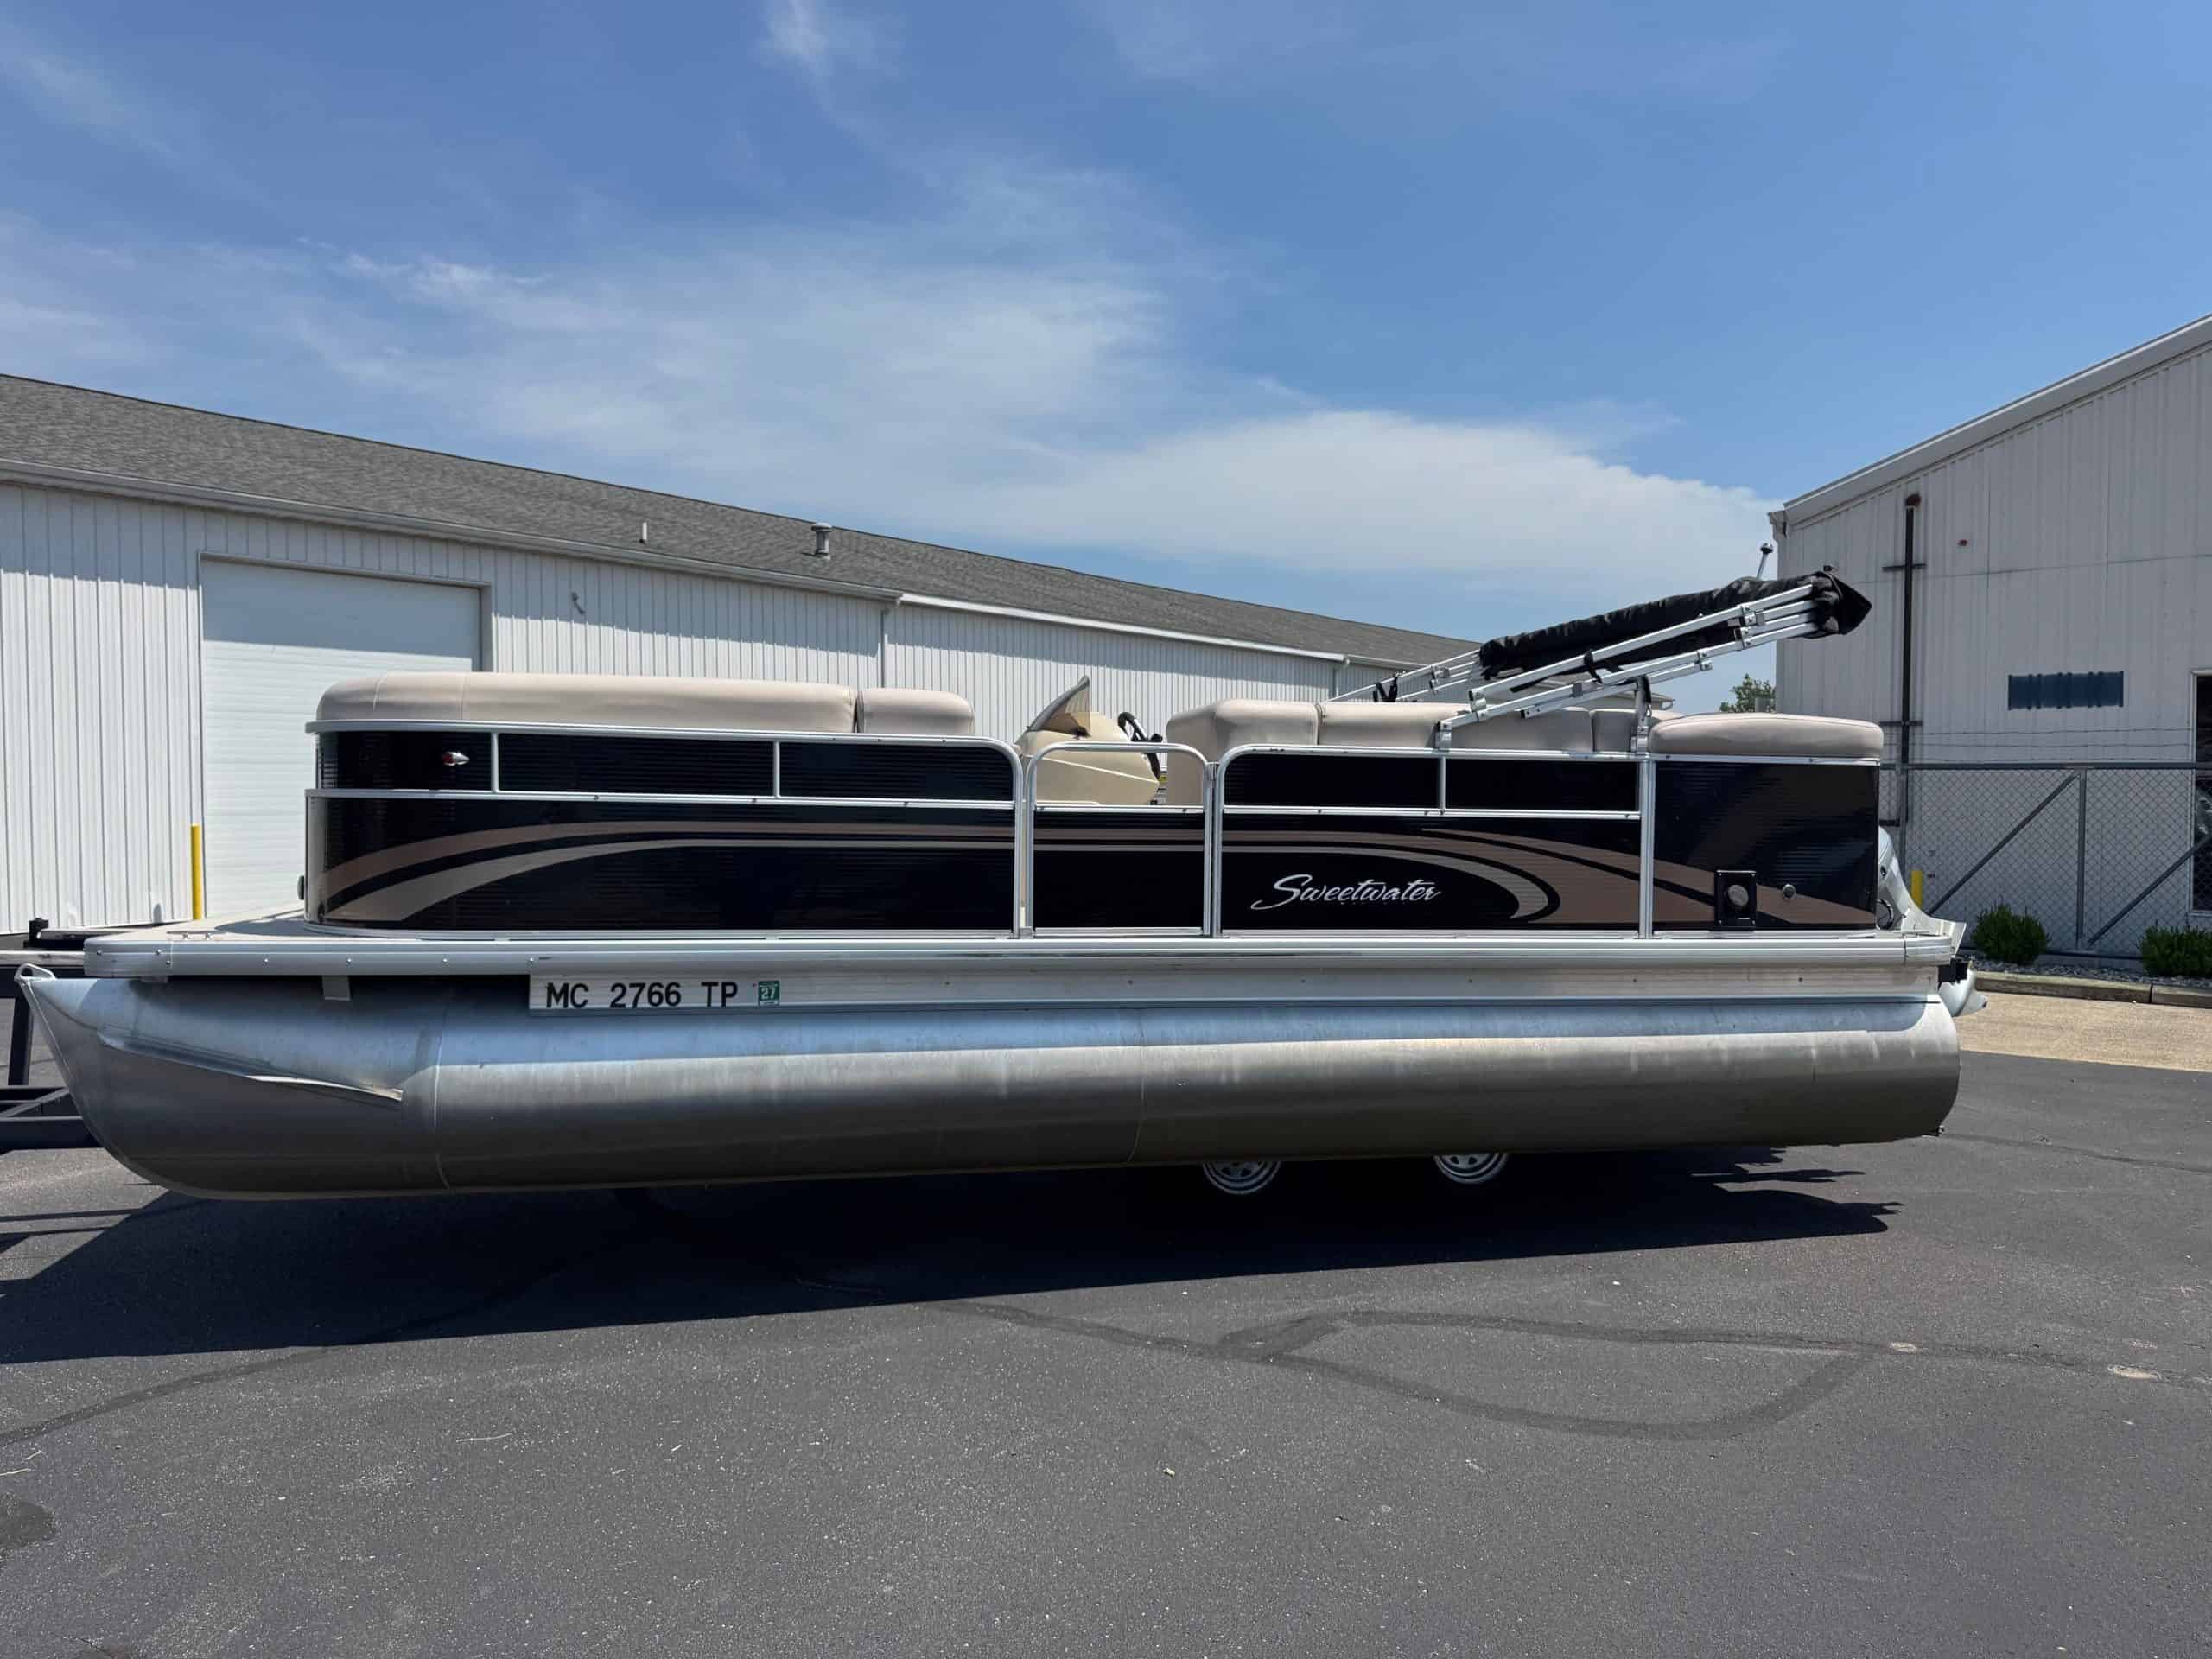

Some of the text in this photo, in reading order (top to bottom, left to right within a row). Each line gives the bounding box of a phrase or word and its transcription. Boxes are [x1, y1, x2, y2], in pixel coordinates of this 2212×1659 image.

[1250, 874, 1442, 910] Sweetwater
[545, 981, 738, 1008] MC 2766 TP
[760, 987, 776, 1000] 27
